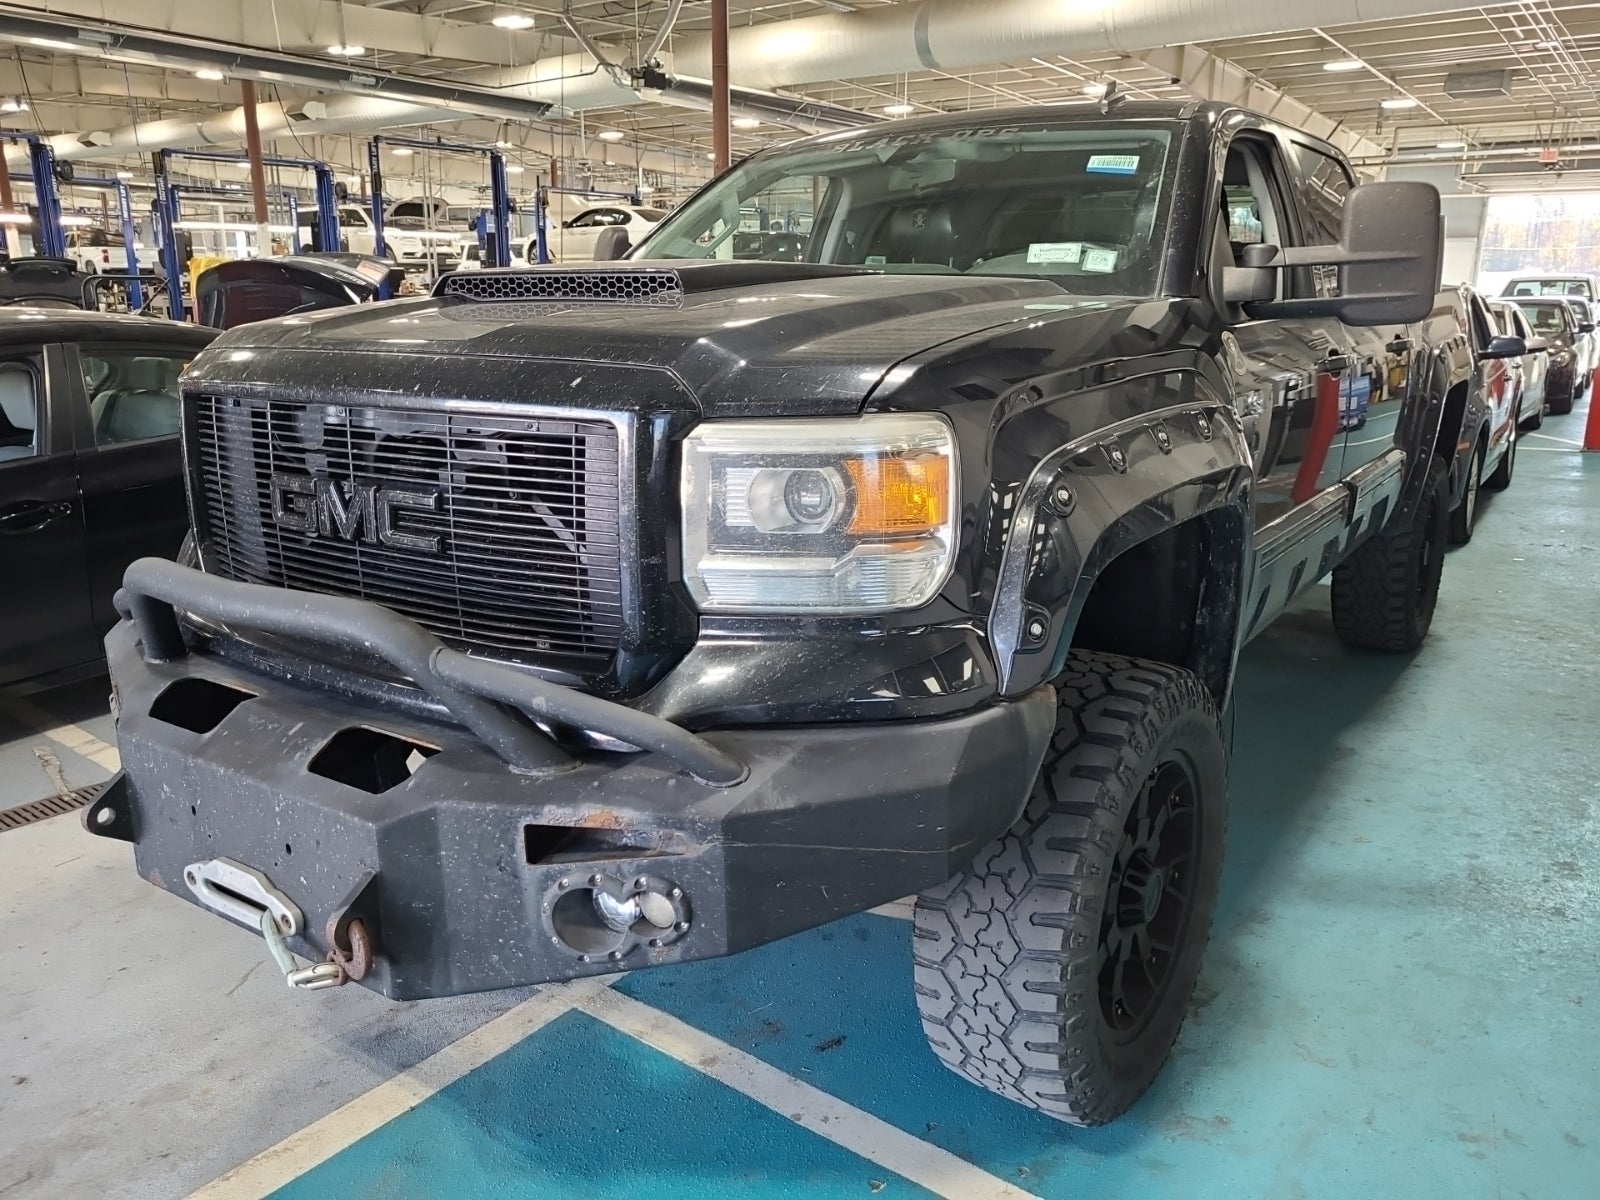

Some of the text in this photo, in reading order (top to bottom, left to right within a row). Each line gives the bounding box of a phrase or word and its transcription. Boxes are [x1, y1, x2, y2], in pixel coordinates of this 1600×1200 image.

[833, 126, 1020, 153] BLACK OPS
[270, 471, 444, 552] GMC
